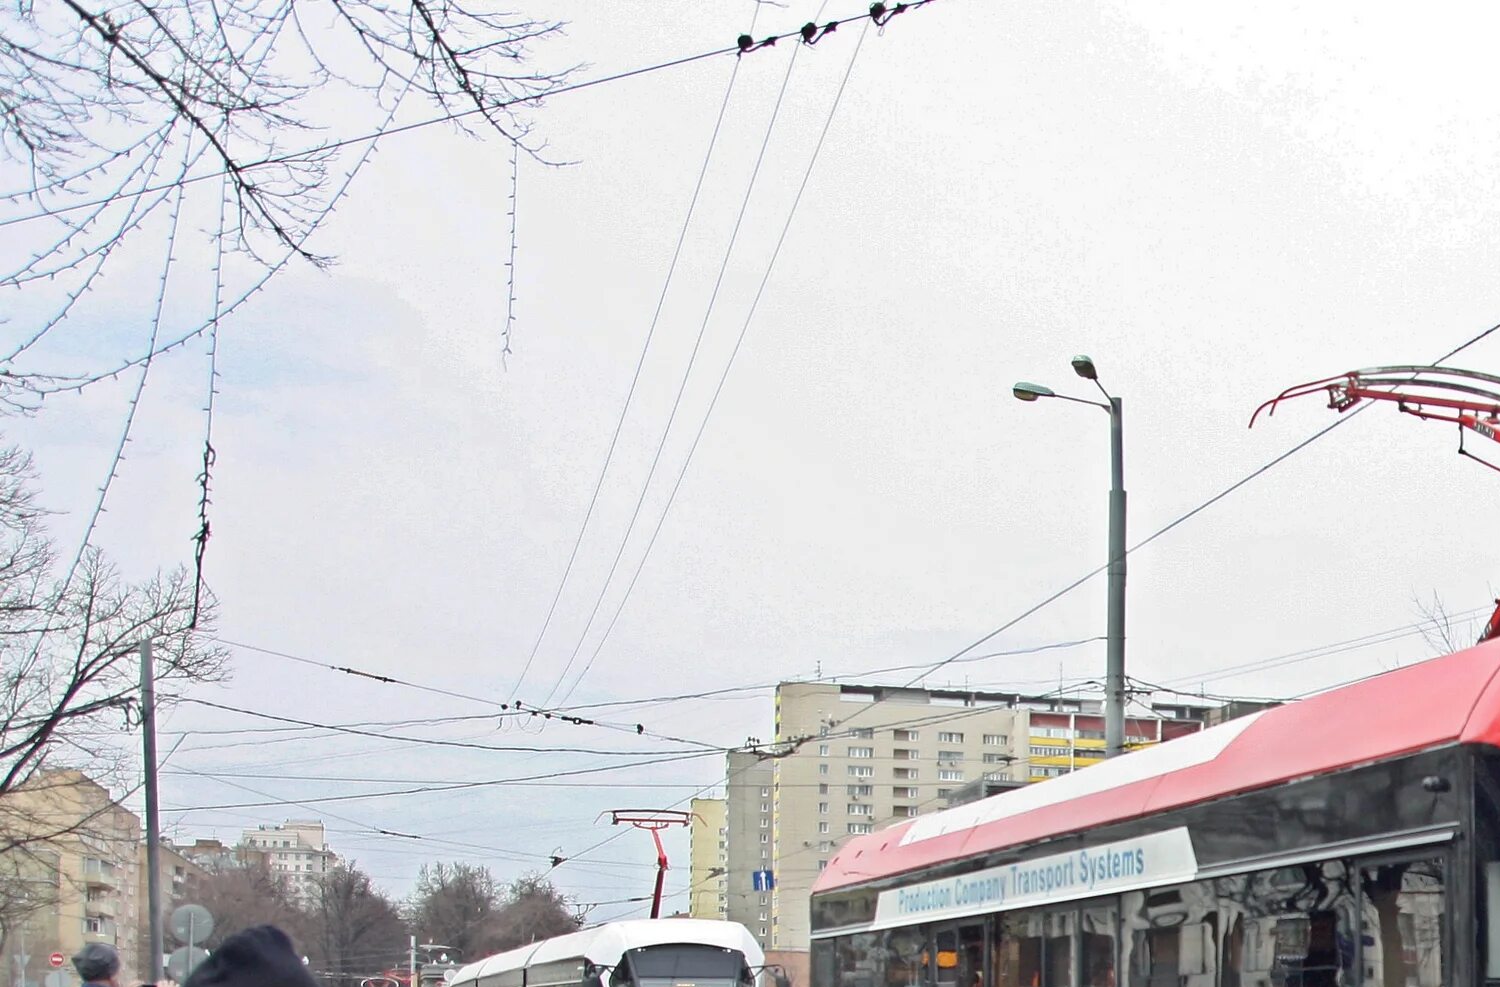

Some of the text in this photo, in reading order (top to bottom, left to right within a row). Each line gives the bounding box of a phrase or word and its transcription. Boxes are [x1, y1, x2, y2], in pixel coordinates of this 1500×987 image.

[898, 848, 1145, 913] Production Company Transport Systems
